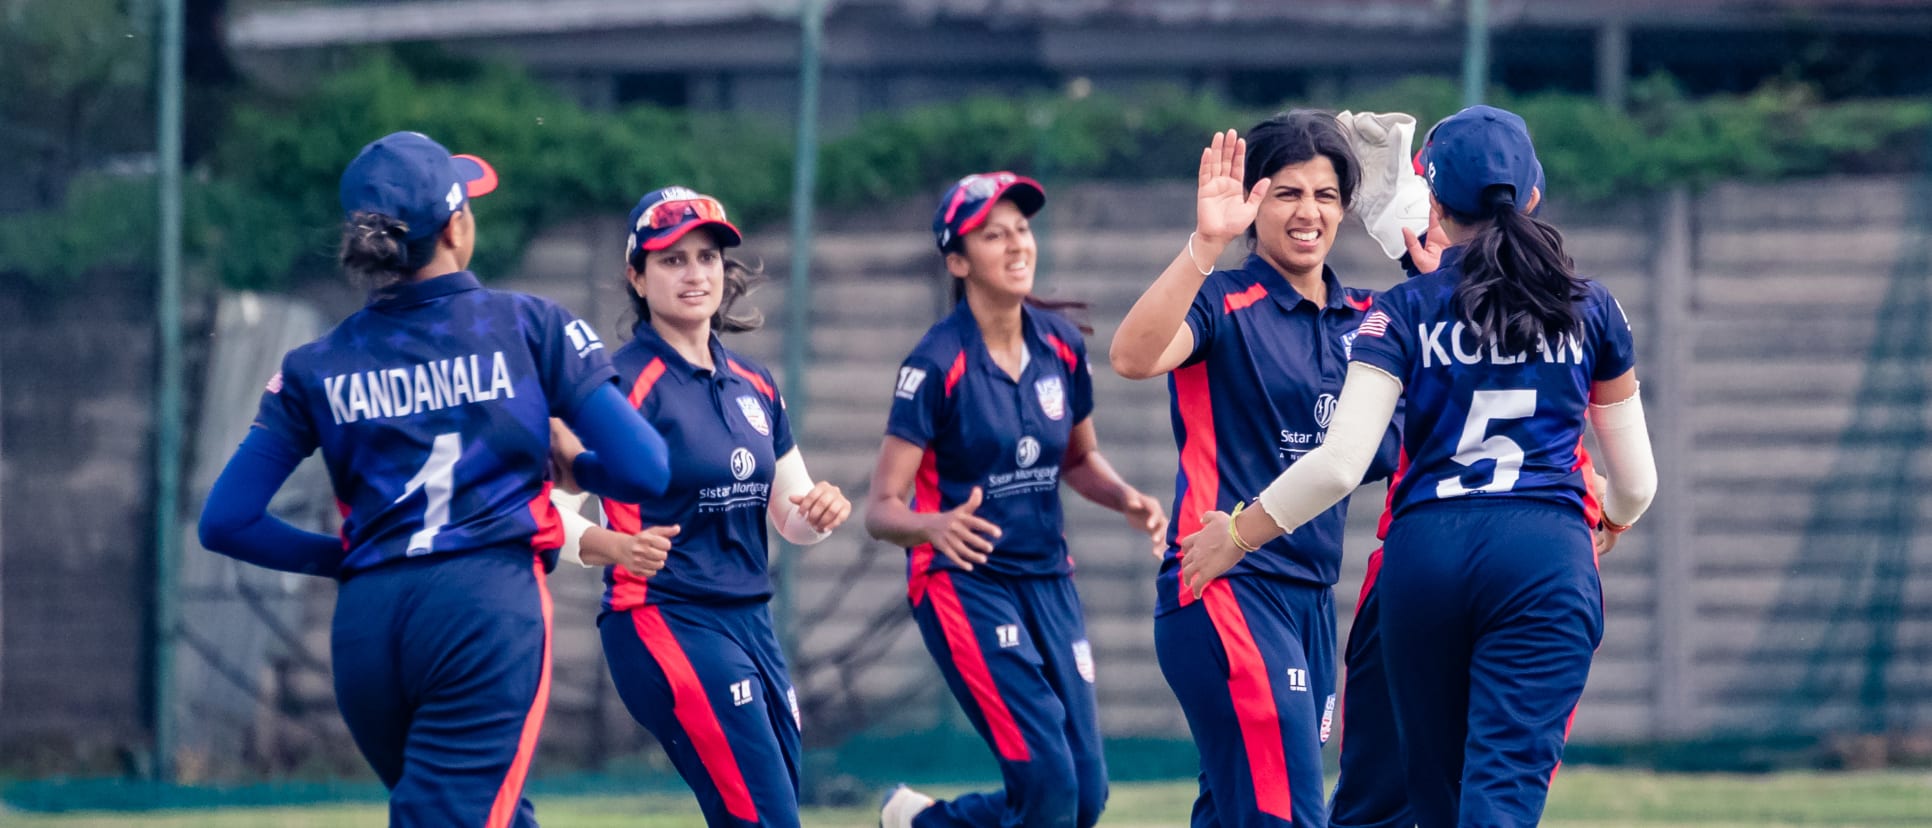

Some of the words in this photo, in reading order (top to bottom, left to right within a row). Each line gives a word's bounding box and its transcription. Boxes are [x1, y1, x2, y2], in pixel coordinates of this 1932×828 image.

[324, 351, 515, 425] KANDANALA
[1280, 429, 1313, 444] Sstar
[1436, 389, 1538, 499] 5
[394, 432, 463, 557] 1
[699, 486, 731, 499] Sistar
